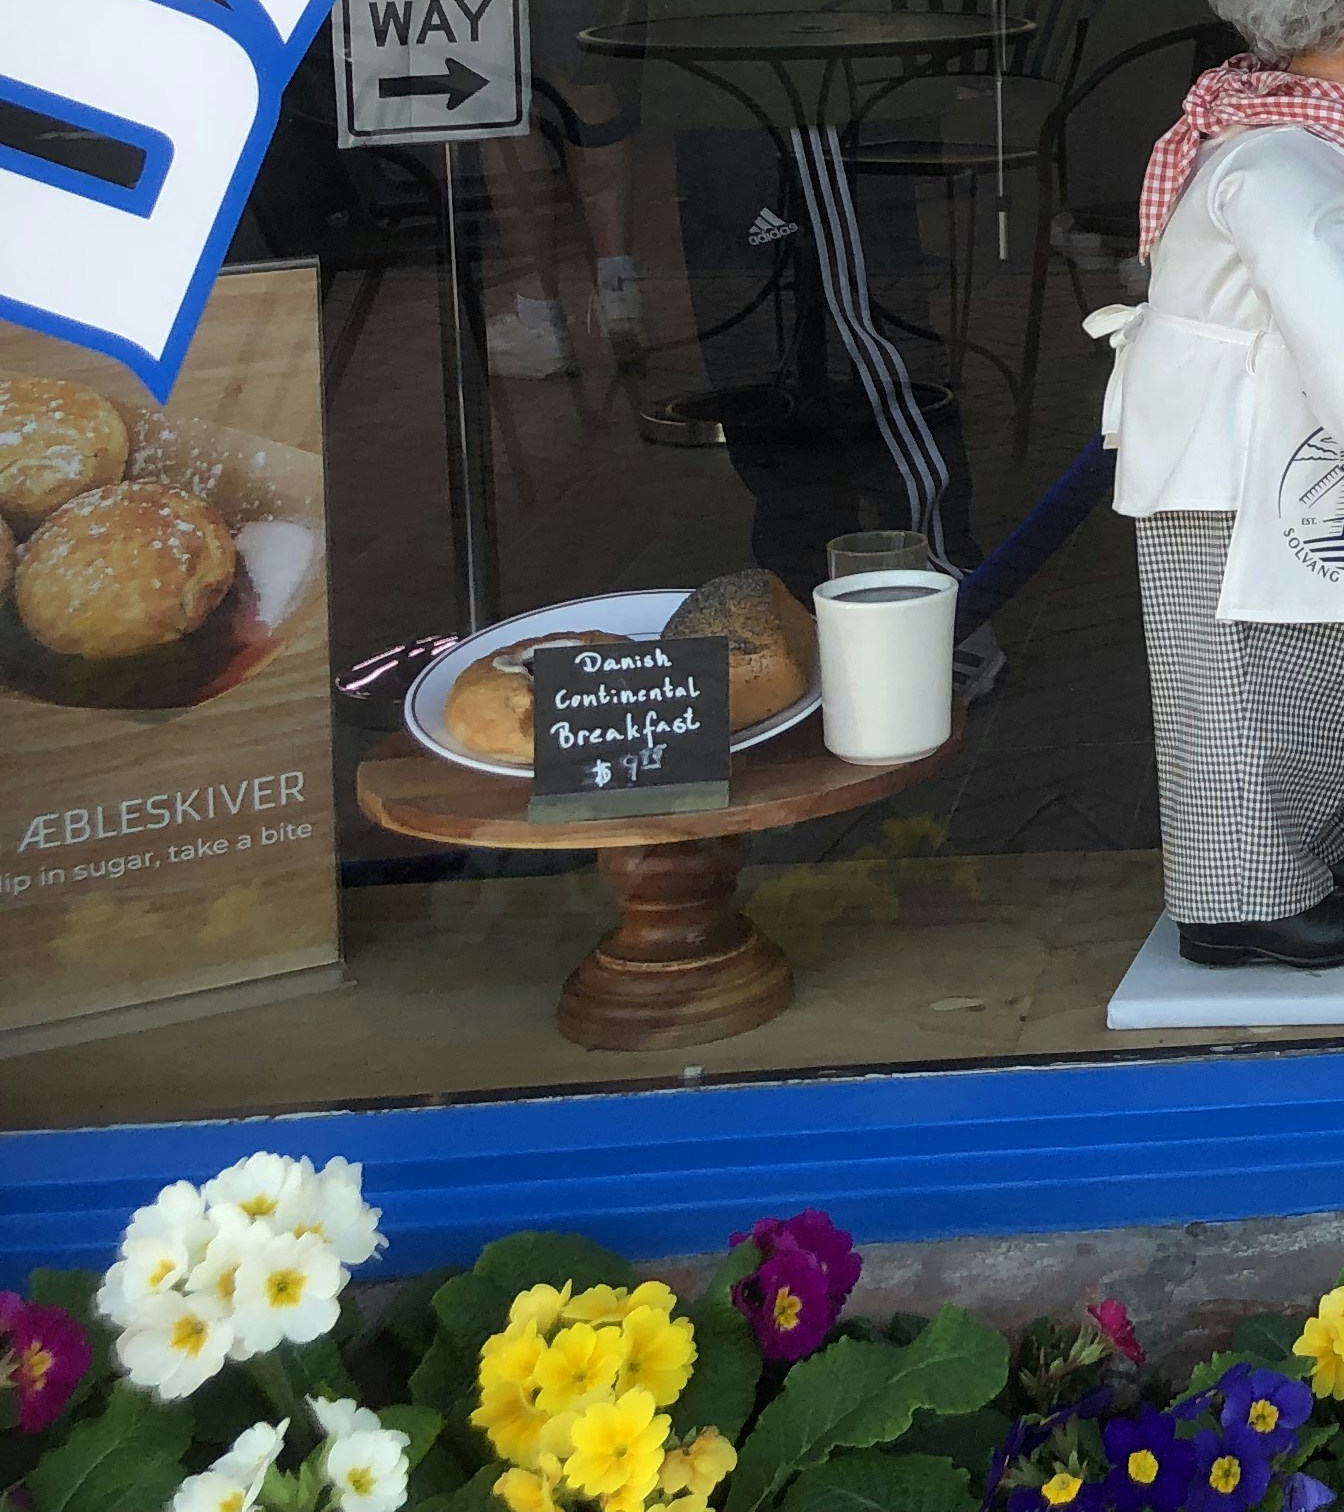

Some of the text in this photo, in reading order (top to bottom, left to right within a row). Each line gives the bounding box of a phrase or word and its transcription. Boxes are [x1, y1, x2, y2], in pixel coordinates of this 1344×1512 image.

[1300, 517, 1318, 526] EST.
[1282, 526, 1341, 583] SOLVANG
[574, 647, 673, 673] Danish
[554, 676, 701, 710] Continental
[549, 706, 701, 749] Breakfast
[16, 770, 306, 854] ÆBLESKIVER
[39, 865, 66, 887] in
[72, 850, 161, 880] sugar,
[167, 836, 230, 864] take
[235, 833, 252, 850] a
[261, 821, 313, 847] bite
